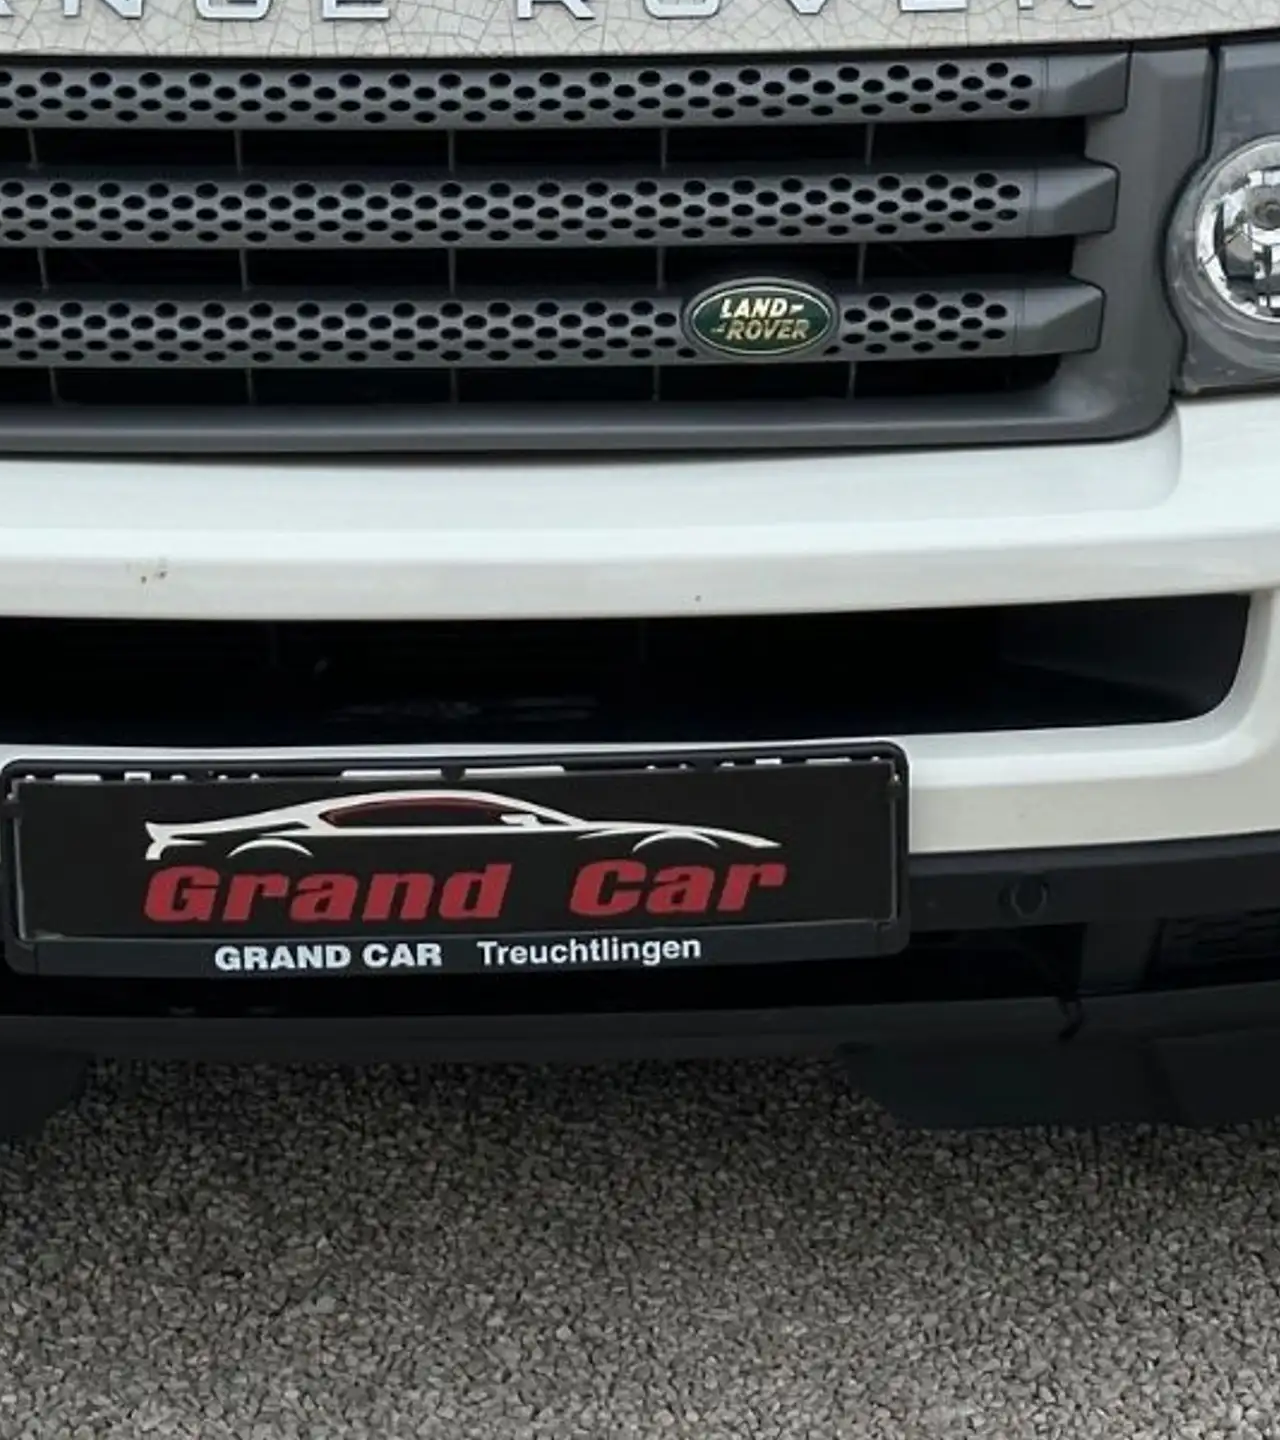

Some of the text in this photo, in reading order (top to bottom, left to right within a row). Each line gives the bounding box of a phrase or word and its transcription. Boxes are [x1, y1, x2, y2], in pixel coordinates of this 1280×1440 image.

[144, 859, 787, 922] Grand Car
[214, 936, 702, 971] GRAND CAR Treuchtlingen
